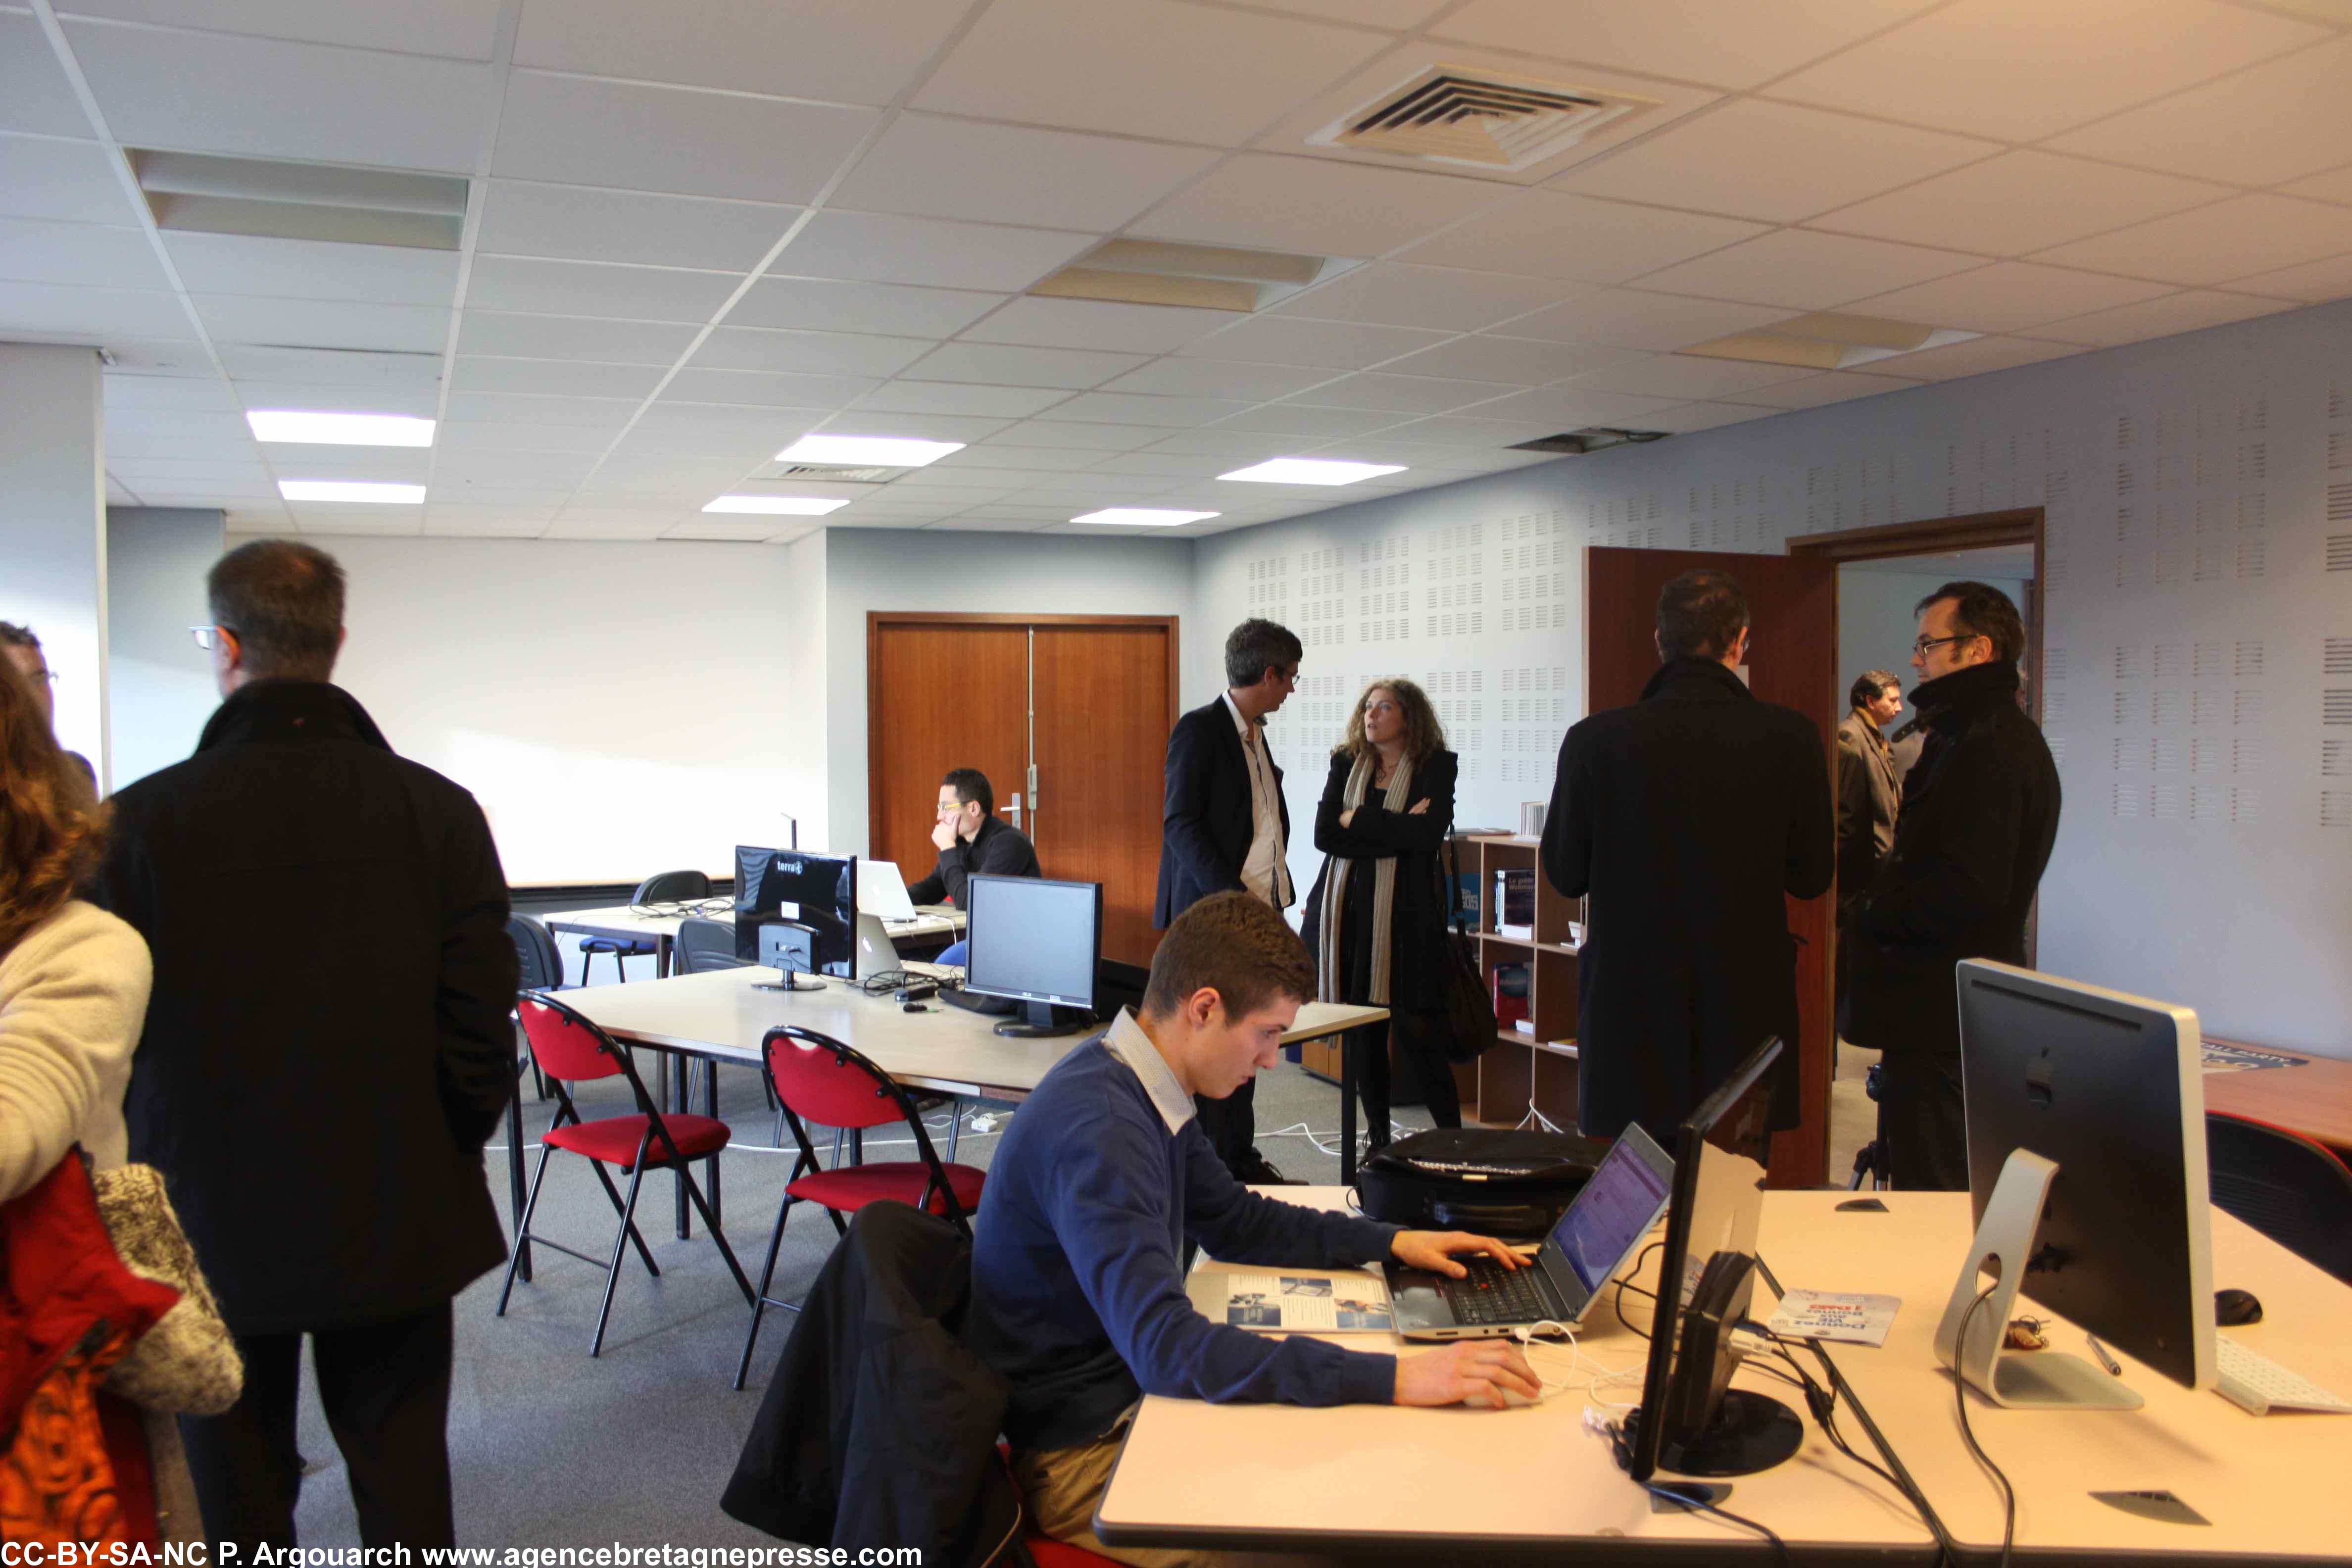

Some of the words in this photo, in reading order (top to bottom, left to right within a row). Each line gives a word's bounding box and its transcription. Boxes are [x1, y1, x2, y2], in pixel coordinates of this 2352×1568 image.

[777, 860, 795, 873] terra
[2235, 1050, 2292, 1062] PARTY
[1794, 1320, 1865, 1329] Donnez
